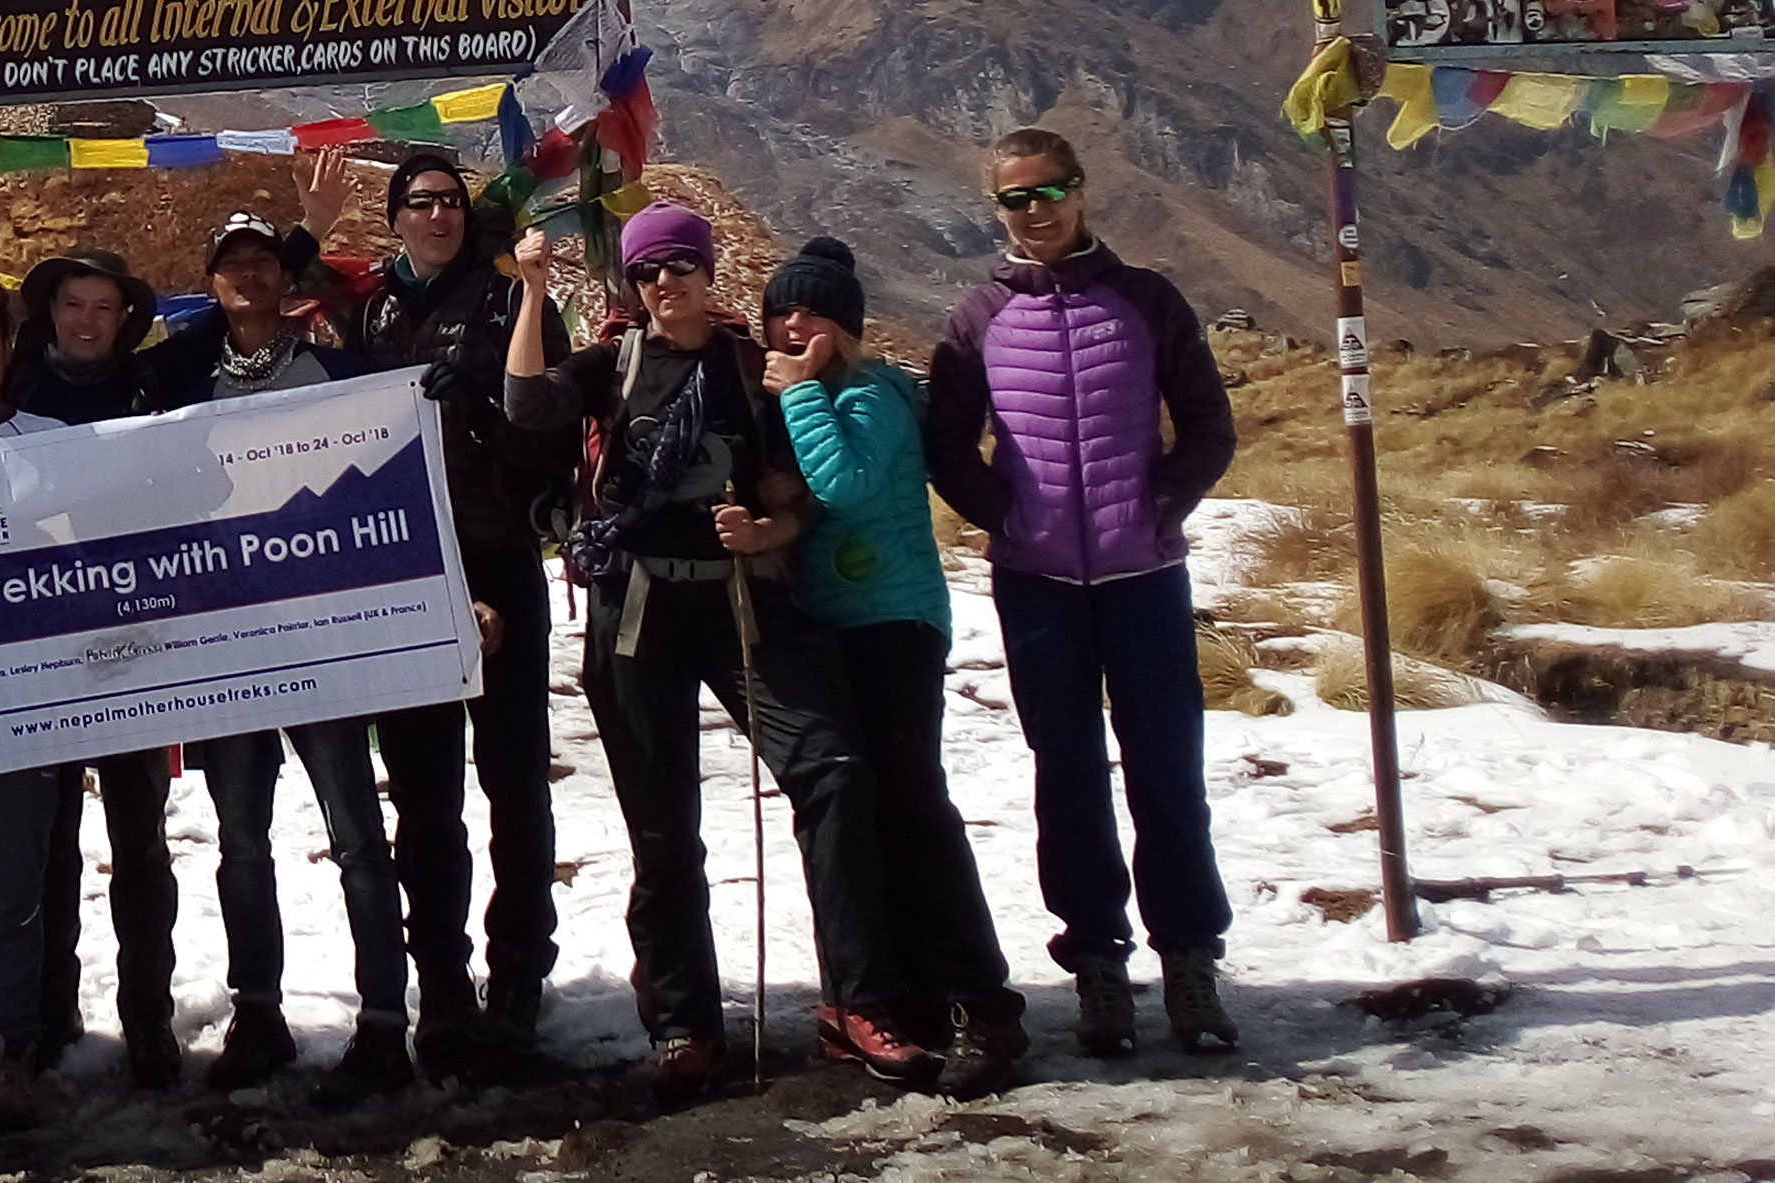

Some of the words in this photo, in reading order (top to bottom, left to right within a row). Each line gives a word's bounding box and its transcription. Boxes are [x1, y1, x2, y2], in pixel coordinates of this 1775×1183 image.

[4, 54, 69, 89] DON'T
[75, 53, 140, 85] PLACE
[148, 50, 194, 78] ANY
[369, 39, 397, 65] ON
[401, 34, 451, 63] THIS
[458, 25, 539, 62] BOARD)
[218, 453, 234, 466] 14
[246, 447, 271, 462] Oct
[274, 443, 294, 456] '18
[297, 441, 310, 453] to
[313, 437, 329, 450] 24
[341, 430, 366, 446] Oct
[369, 427, 390, 441] '18
[148, 540, 228, 580] with
[240, 528, 340, 566] Poon
[351, 509, 410, 549] Hill
[232, 626, 276, 640] Veronica
[10, 675, 318, 737] www.nepalmotherhousetreks.com
